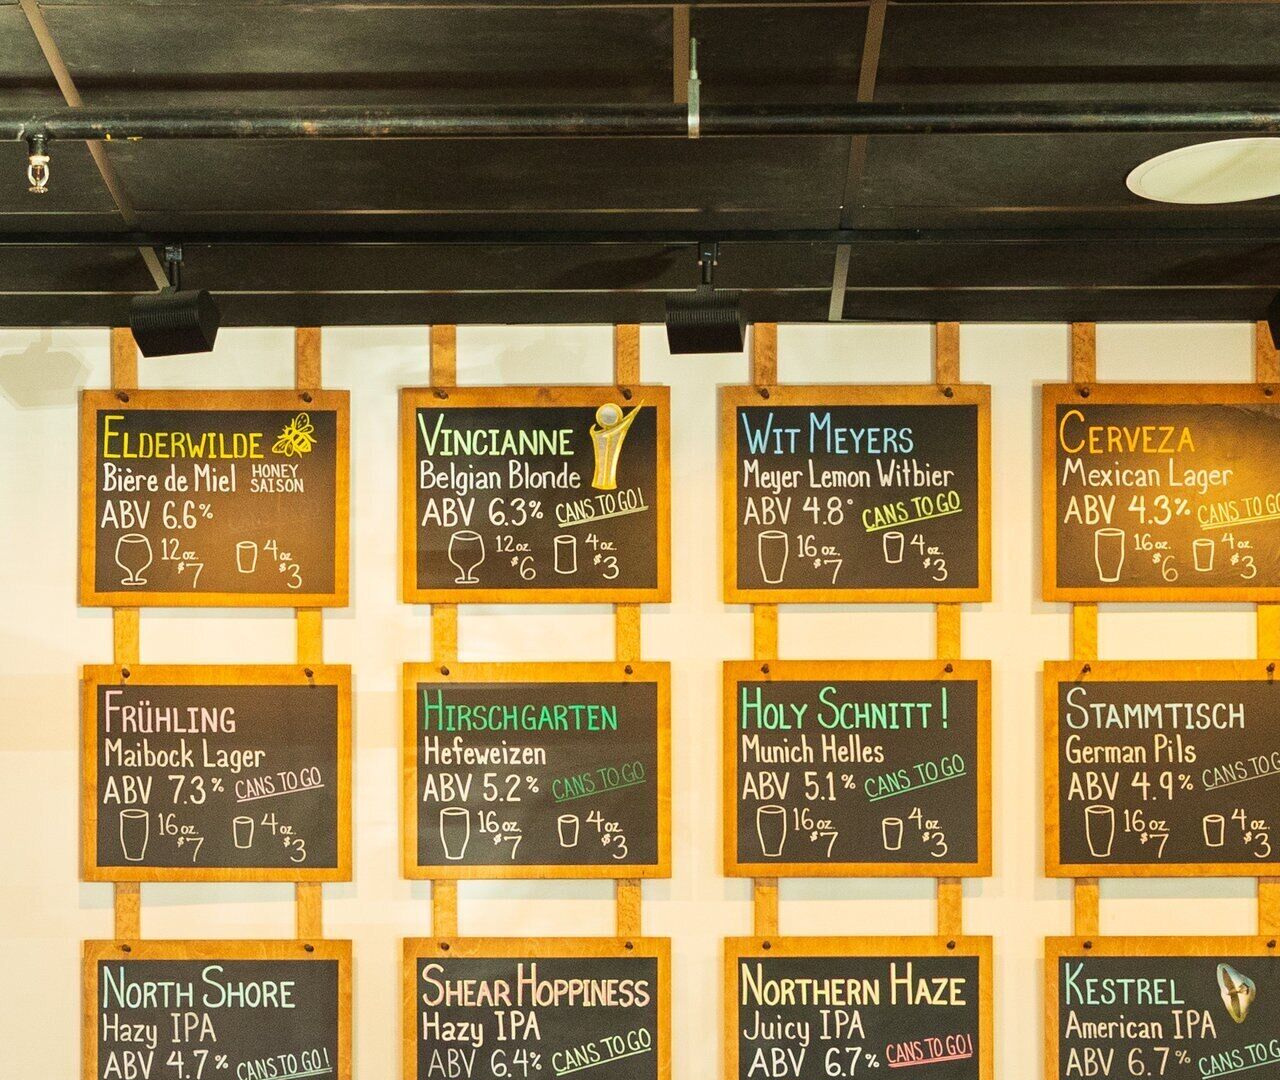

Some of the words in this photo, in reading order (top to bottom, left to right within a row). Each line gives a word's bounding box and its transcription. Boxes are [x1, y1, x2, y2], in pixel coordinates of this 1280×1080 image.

[103, 416, 264, 459] ELDERWILDE
[418, 413, 574, 456] VINCIANNE
[742, 413, 801, 455] WIT
[810, 412, 913, 454] MEYERS
[1060, 410, 1195, 453] CERVEZA
[103, 463, 158, 492] Bière
[165, 464, 188, 492] de
[194, 463, 236, 492] Miel
[250, 479, 304, 493] SAISON
[252, 464, 299, 478] HONEY
[420, 460, 501, 496] Belgian
[509, 460, 581, 489] Blonde
[743, 459, 803, 494] Meyer
[808, 459, 870, 488] Lemon
[876, 459, 954, 487] Witbier
[1063, 458, 1160, 487] Mexican
[1169, 458, 1233, 494] Lager
[105, 690, 236, 734] FRÜHLING
[423, 689, 618, 731] HIRSCHGARTEN
[742, 687, 808, 730] HOLY
[1066, 687, 1245, 730] STAMMTISCH
[105, 738, 194, 768] Maibock
[203, 738, 265, 773] Lager
[425, 736, 546, 765] Hefeweizen
[742, 734, 814, 763] Munich
[822, 734, 884, 763] Helles
[1066, 734, 1147, 764] German
[1154, 734, 1196, 763] Pils
[103, 965, 193, 1009] NORTH
[202, 965, 295, 1009] SHORE
[422, 963, 512, 1007] SHEAR
[517, 963, 650, 1007] HOPPINESS
[742, 963, 880, 1006] NORTHERN
[890, 962, 966, 1006] HAZE
[1065, 962, 1185, 1005] KESTREL
[103, 1013, 157, 1049] Hazy
[171, 1012, 217, 1043] IPA
[422, 1011, 484, 1048] Hazy
[494, 1011, 540, 1041] IPA
[743, 1010, 810, 1047] Juicy
[820, 1010, 865, 1040] IPA
[1066, 1010, 1163, 1040] American
[1172, 1010, 1217, 1040] IPA
